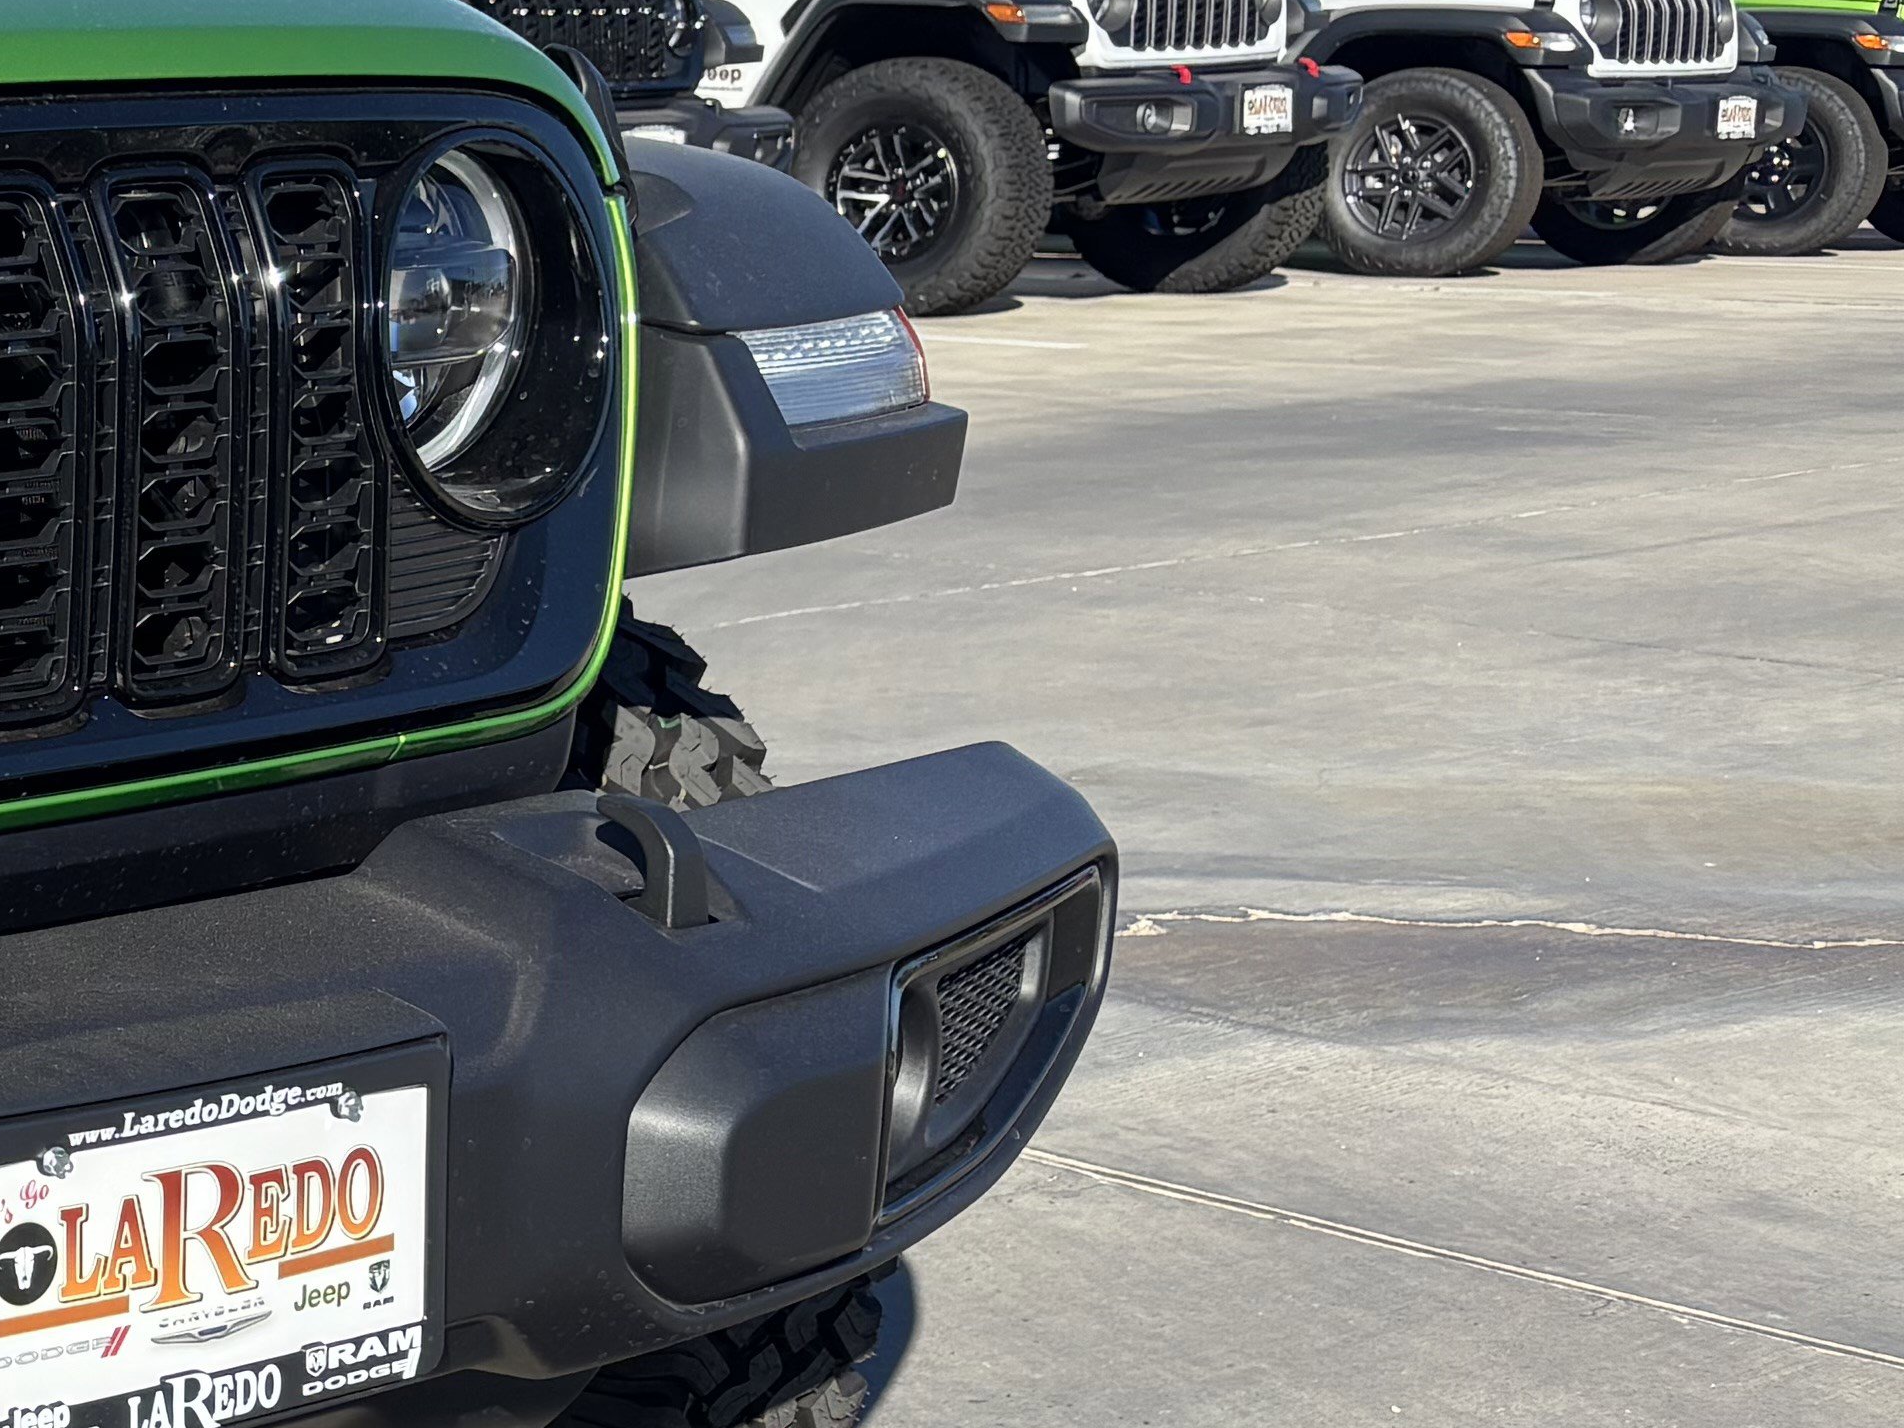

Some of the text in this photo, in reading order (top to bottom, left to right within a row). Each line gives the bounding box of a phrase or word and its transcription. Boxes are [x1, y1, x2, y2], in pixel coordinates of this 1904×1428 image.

[68, 1081, 343, 1148] www.LaredoDodge.com
[19, 1179, 50, 1210] Go
[57, 1143, 385, 1314] LAREDO
[293, 1280, 351, 1312] Jeep
[362, 1295, 395, 1311] RAM
[328, 1324, 423, 1370] RAM
[301, 1356, 411, 1397] DODGE
